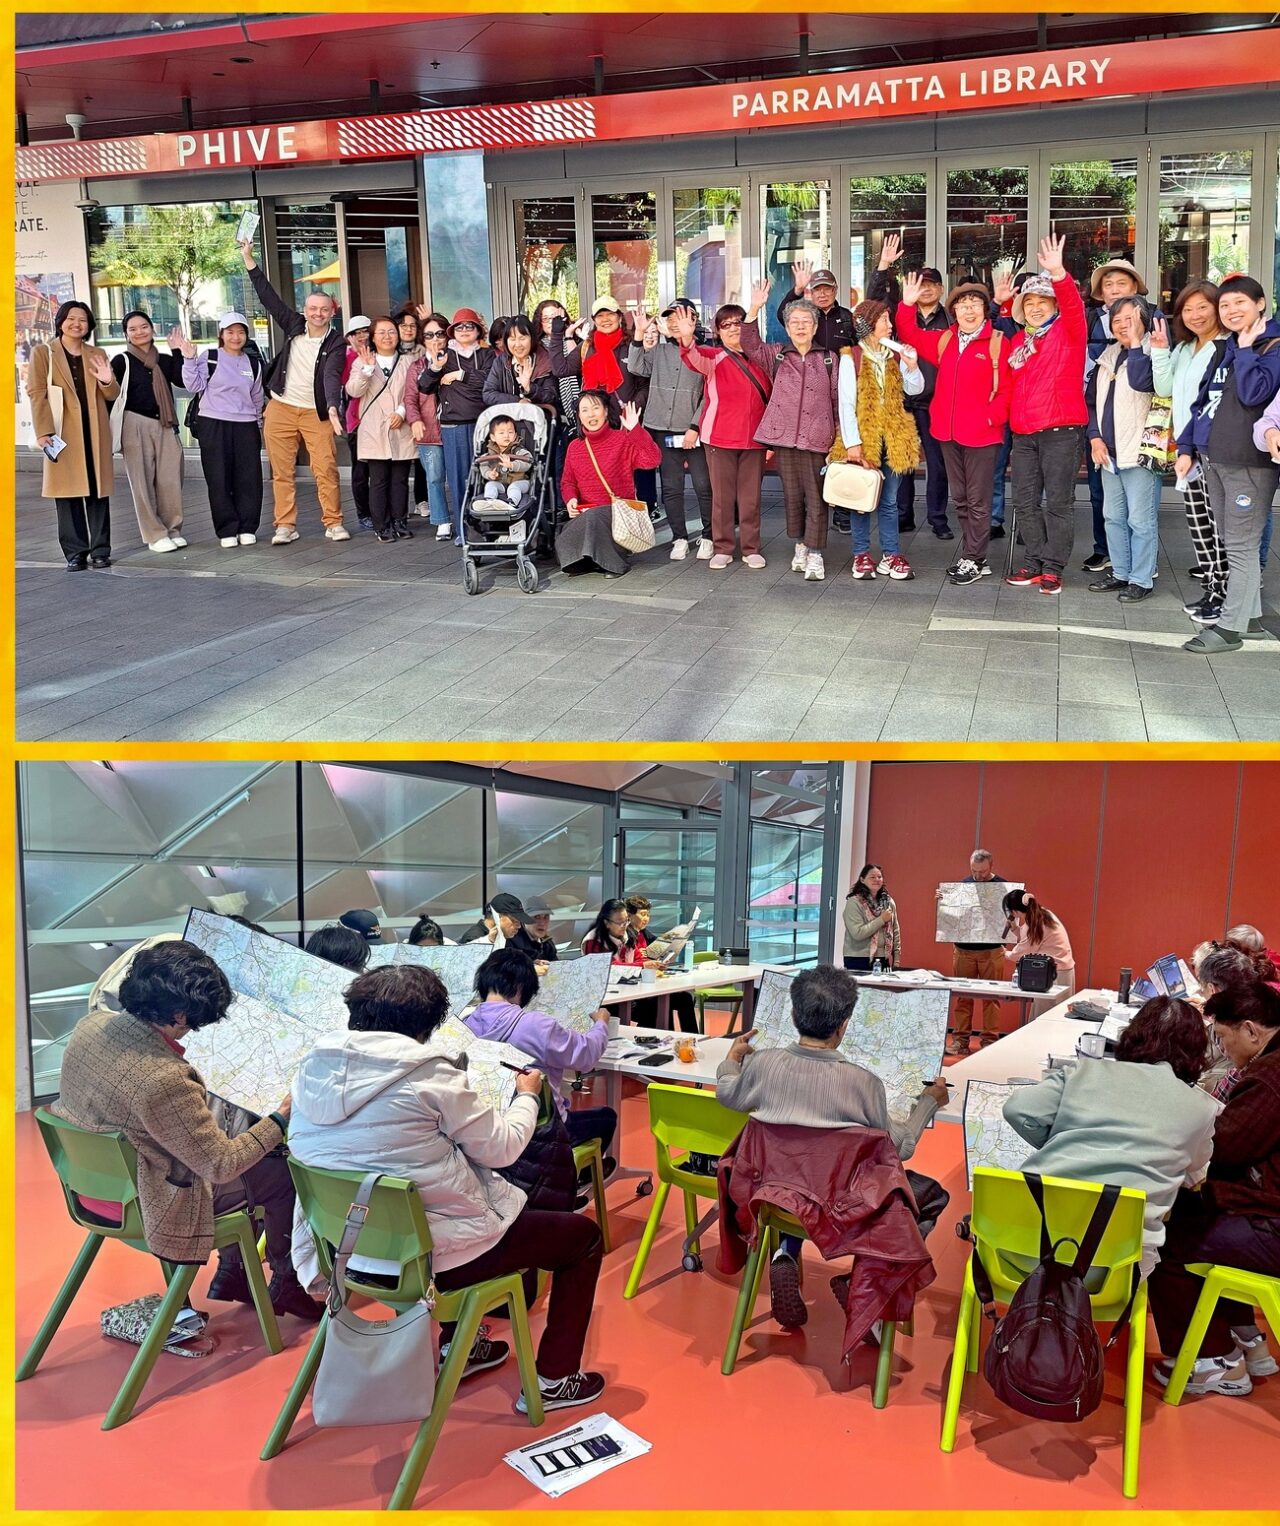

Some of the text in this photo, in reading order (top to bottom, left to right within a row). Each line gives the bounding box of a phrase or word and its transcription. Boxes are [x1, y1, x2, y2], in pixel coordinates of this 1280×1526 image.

[732, 57, 1112, 118] PARRAMATTA LIBRARY
[177, 126, 298, 167] PHIVE
